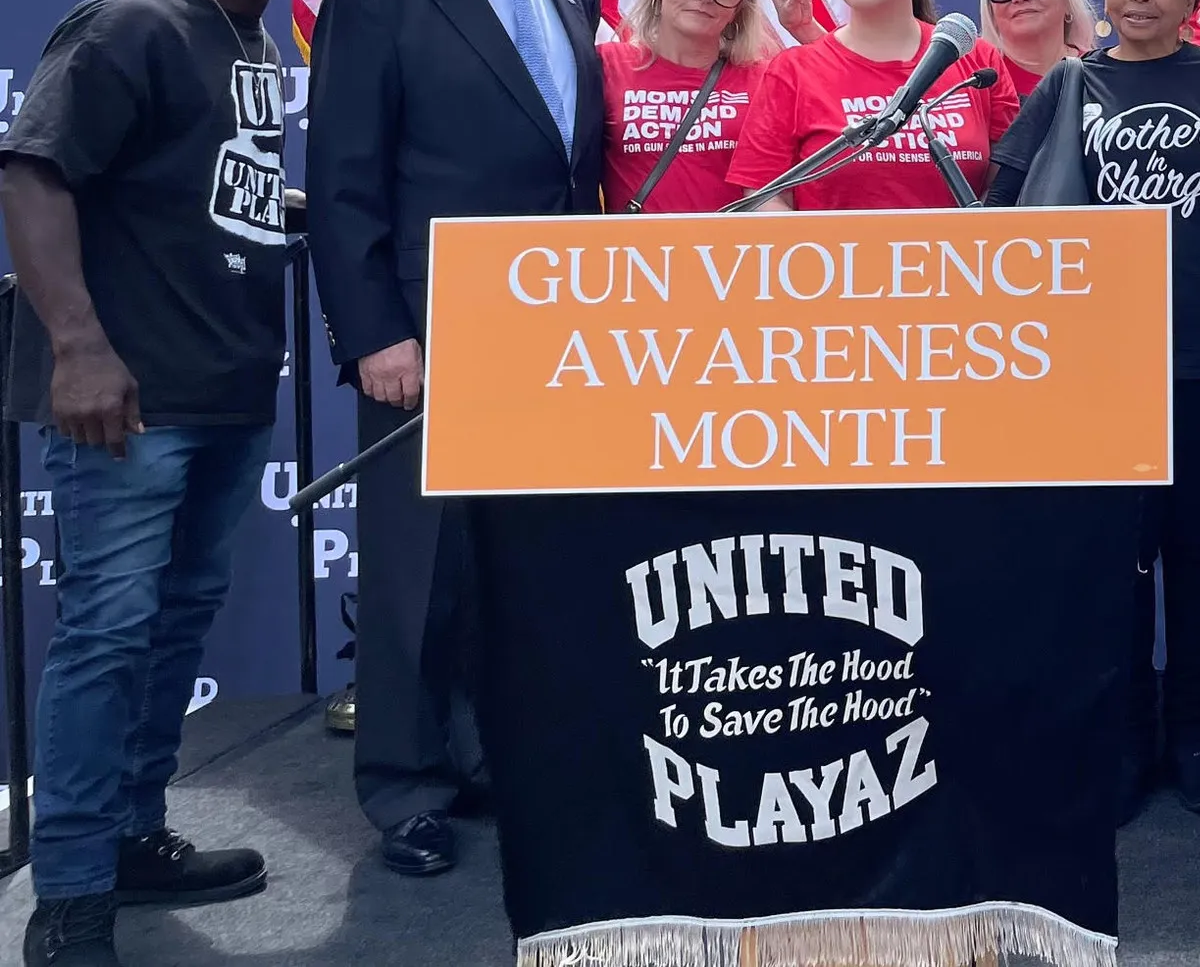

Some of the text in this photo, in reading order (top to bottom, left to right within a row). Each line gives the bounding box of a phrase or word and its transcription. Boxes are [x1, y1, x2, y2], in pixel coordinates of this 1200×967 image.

[622, 121, 722, 140] ACTON
[846, 113, 965, 130] DAND
[623, 143, 641, 153] FOR
[644, 143, 664, 152] GUN
[696, 142, 705, 152] IN
[708, 140, 738, 151] AMER
[853, 151, 983, 163] OR GUN SENSE MERICA
[1146, 149, 1168, 172] In
[224, 158, 285, 200] UNIT
[508, 238, 1092, 305] GUN VIOLENCE
[545, 321, 1052, 388] AWARENESS
[649, 407, 947, 470] MONTH
[625, 534, 924, 650] UNITED
[684, 655, 784, 693] Takes
[788, 650, 840, 688] The
[841, 648, 914, 683] Hood
[659, 704, 689, 738] To
[700, 702, 783, 738] Save
[788, 695, 842, 732] The
[643, 716, 938, 847] PLAYAZ
